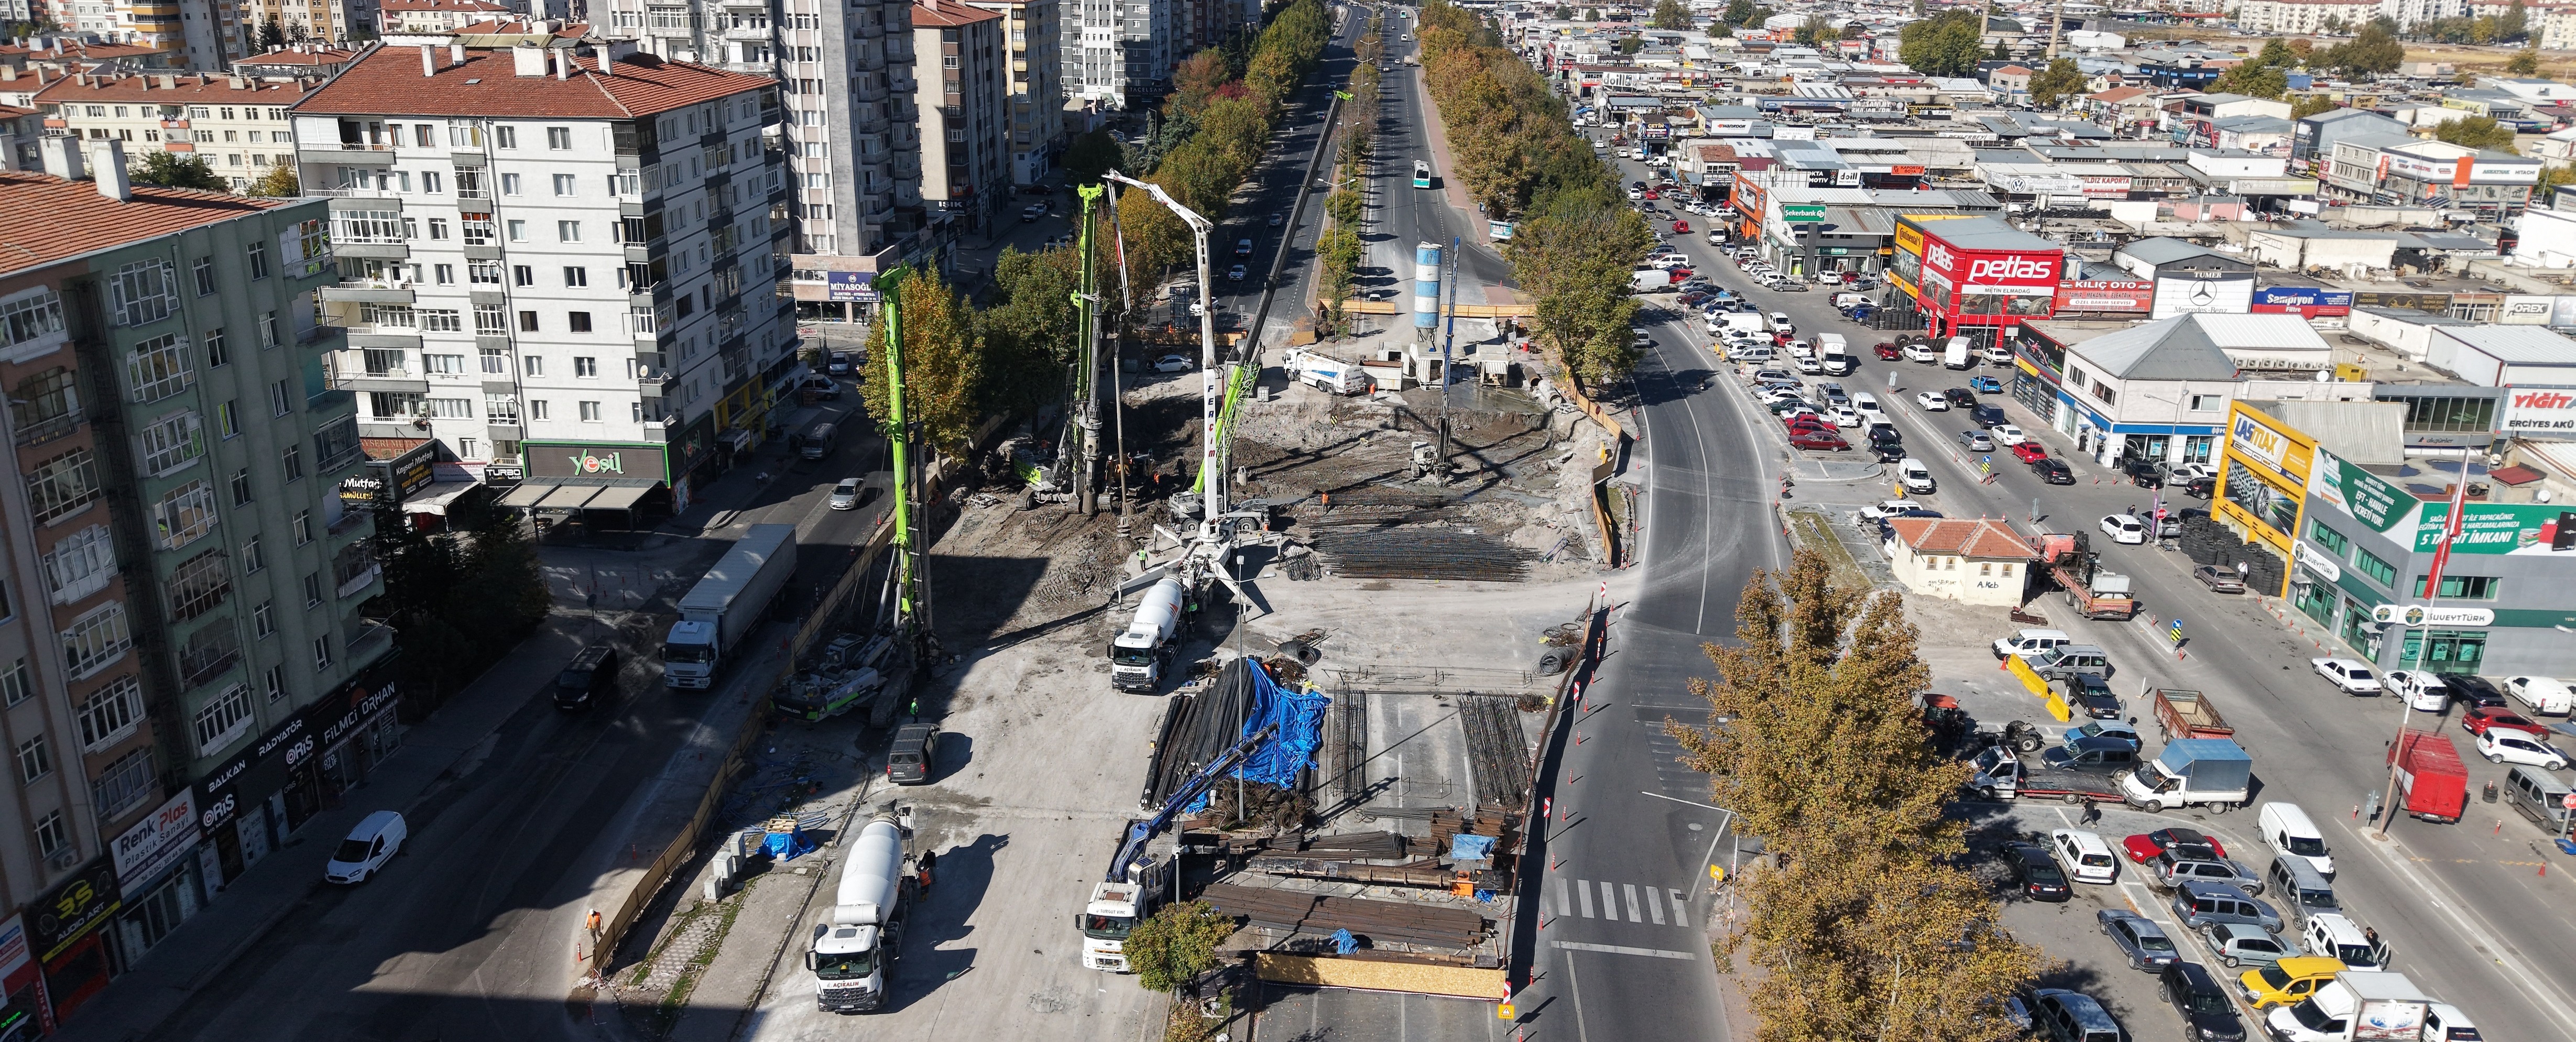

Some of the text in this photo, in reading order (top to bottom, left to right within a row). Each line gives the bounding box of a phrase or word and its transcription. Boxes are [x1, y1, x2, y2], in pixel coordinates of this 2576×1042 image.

[1604, 73, 1625, 85] doill
[1899, 227, 1918, 244] Continental
[1927, 243, 1955, 272] petlas
[1969, 256, 2053, 280] petlas
[830, 281, 871, 291] MİYASOĞL
[2076, 281, 2107, 290] KILIÇ
[2515, 304, 2544, 313] OREX
[2514, 392, 2573, 409] YİĞİT
[2509, 419, 2574, 428] ERCİYES AKÜ
[2234, 418, 2279, 456] LASMAX
[396, 451, 434, 476] Kayseri Mutfağı
[569, 448, 625, 476] Yeşil
[2253, 471, 2265, 485] LASPA
[2355, 490, 2388, 515] EFT HAVALE
[2354, 501, 2385, 527] ÜCRETİ YOK!
[2429, 514, 2446, 523] SAĞLA
[2467, 521, 2520, 530] HARCAMALARINIZA
[2420, 534, 2430, 545] 5
[2469, 530, 2514, 544] İMKANI
[362, 681, 395, 715] ORHAN
[779, 705, 801, 714] ZOOMLION
[209, 719, 303, 793] BALKAN RADYATÖR
[297, 752, 313, 767] RADYATÖR
[324, 754, 335, 766] OTO
[121, 802, 188, 857] Renk Plas
[216, 813, 234, 829] RADYATÖR
[126, 815, 189, 868] Plastik Sanayi
[57, 918, 84, 942] AUDIO
[87, 902, 104, 920] ART
[36, 980, 51, 1028] ECZANE
